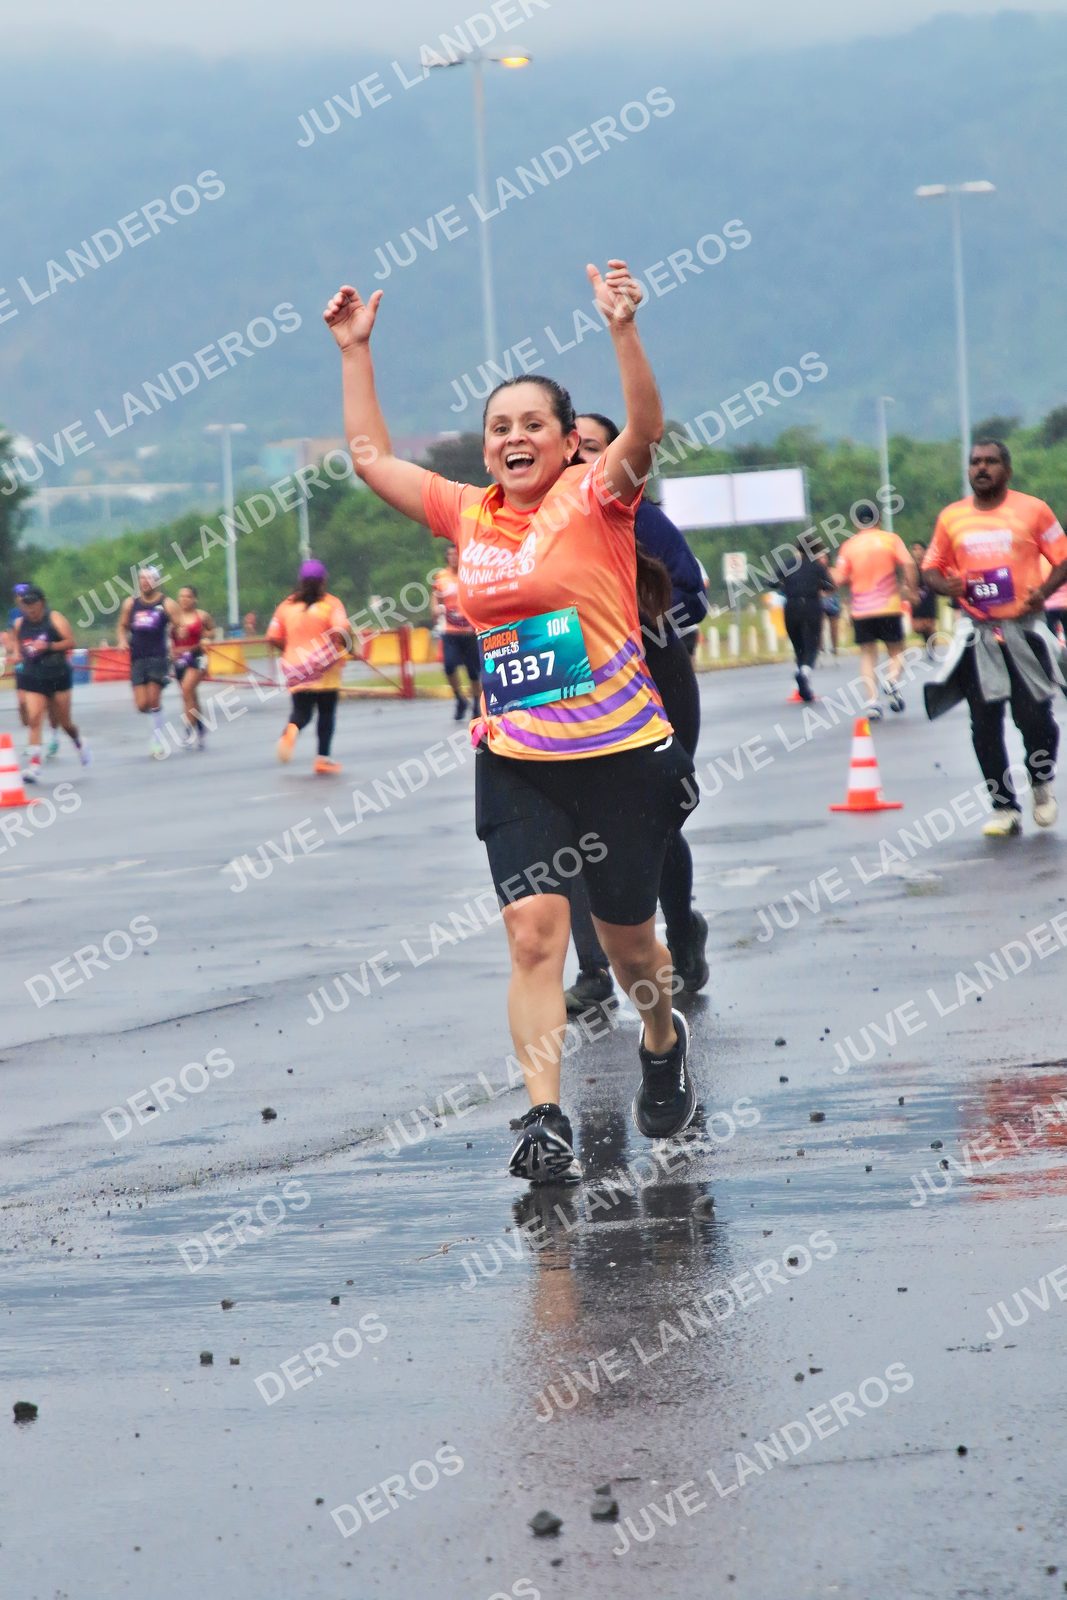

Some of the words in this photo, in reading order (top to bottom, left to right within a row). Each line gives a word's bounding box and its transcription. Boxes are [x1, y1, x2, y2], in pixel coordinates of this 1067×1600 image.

[975, 583, 998, 598] 633
[546, 616, 570, 637] 10K
[483, 630, 518, 651] CARRERA
[496, 650, 555, 687] 1337
